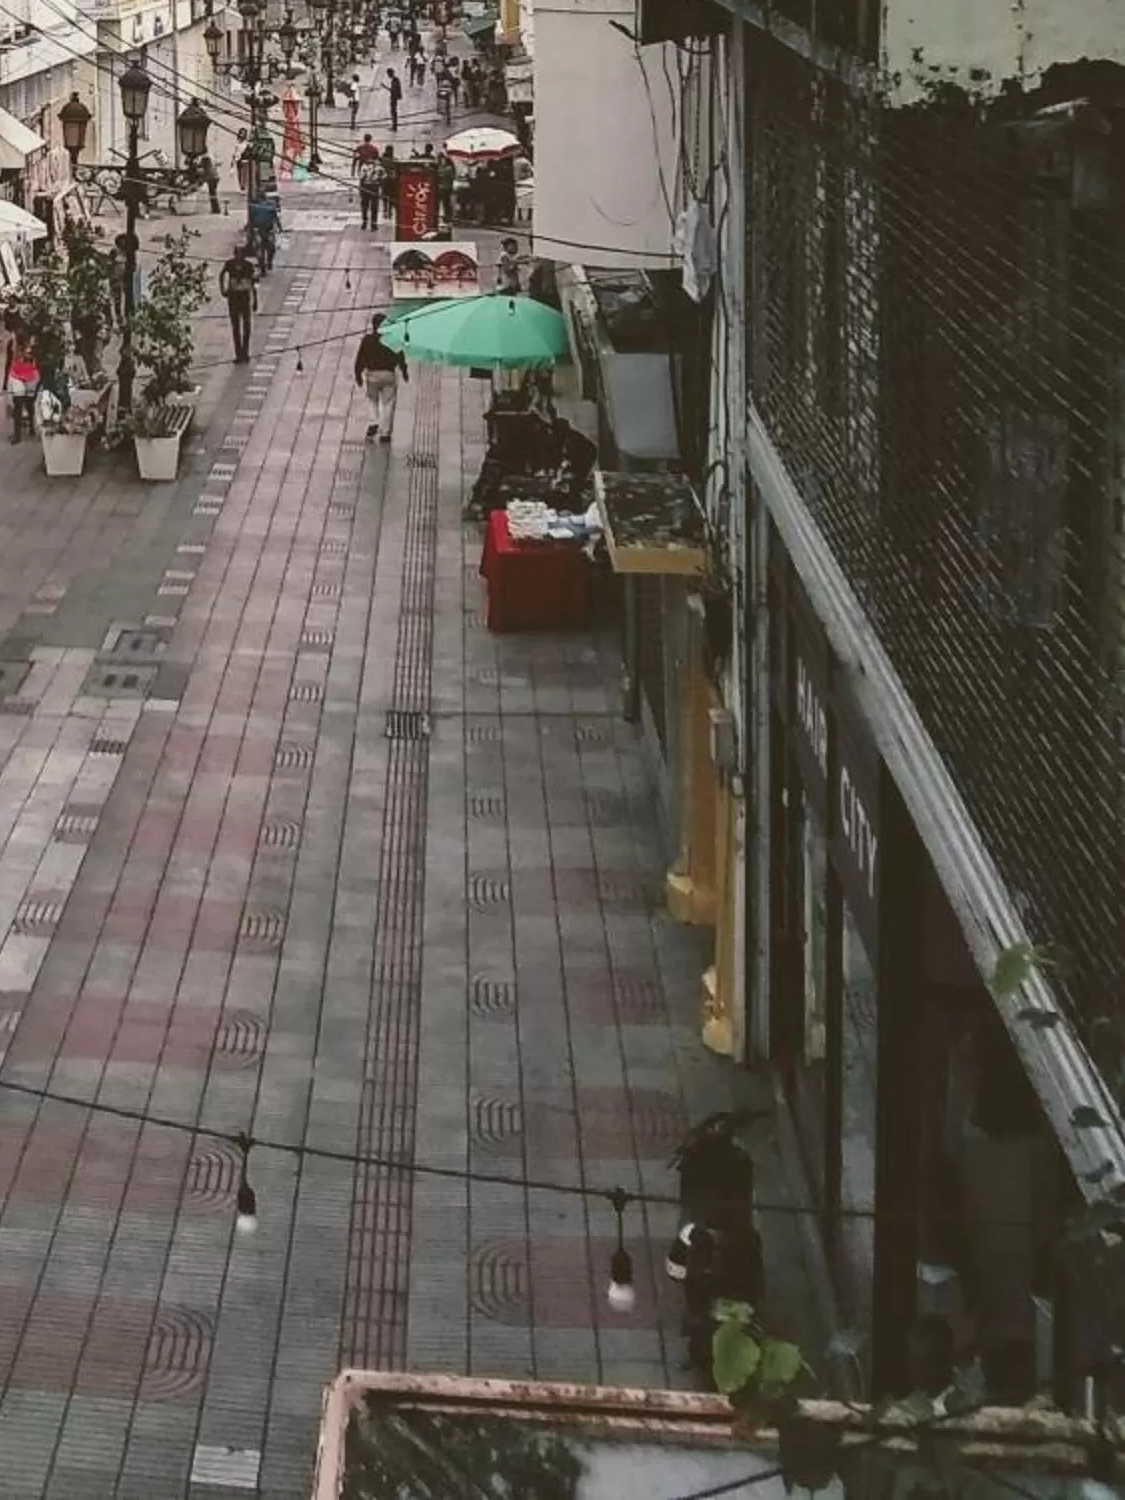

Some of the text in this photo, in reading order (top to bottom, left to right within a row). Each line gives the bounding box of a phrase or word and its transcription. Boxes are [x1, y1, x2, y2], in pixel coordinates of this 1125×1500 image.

[409, 182, 430, 235] Claro
[797, 655, 878, 897] HAIR CITY
